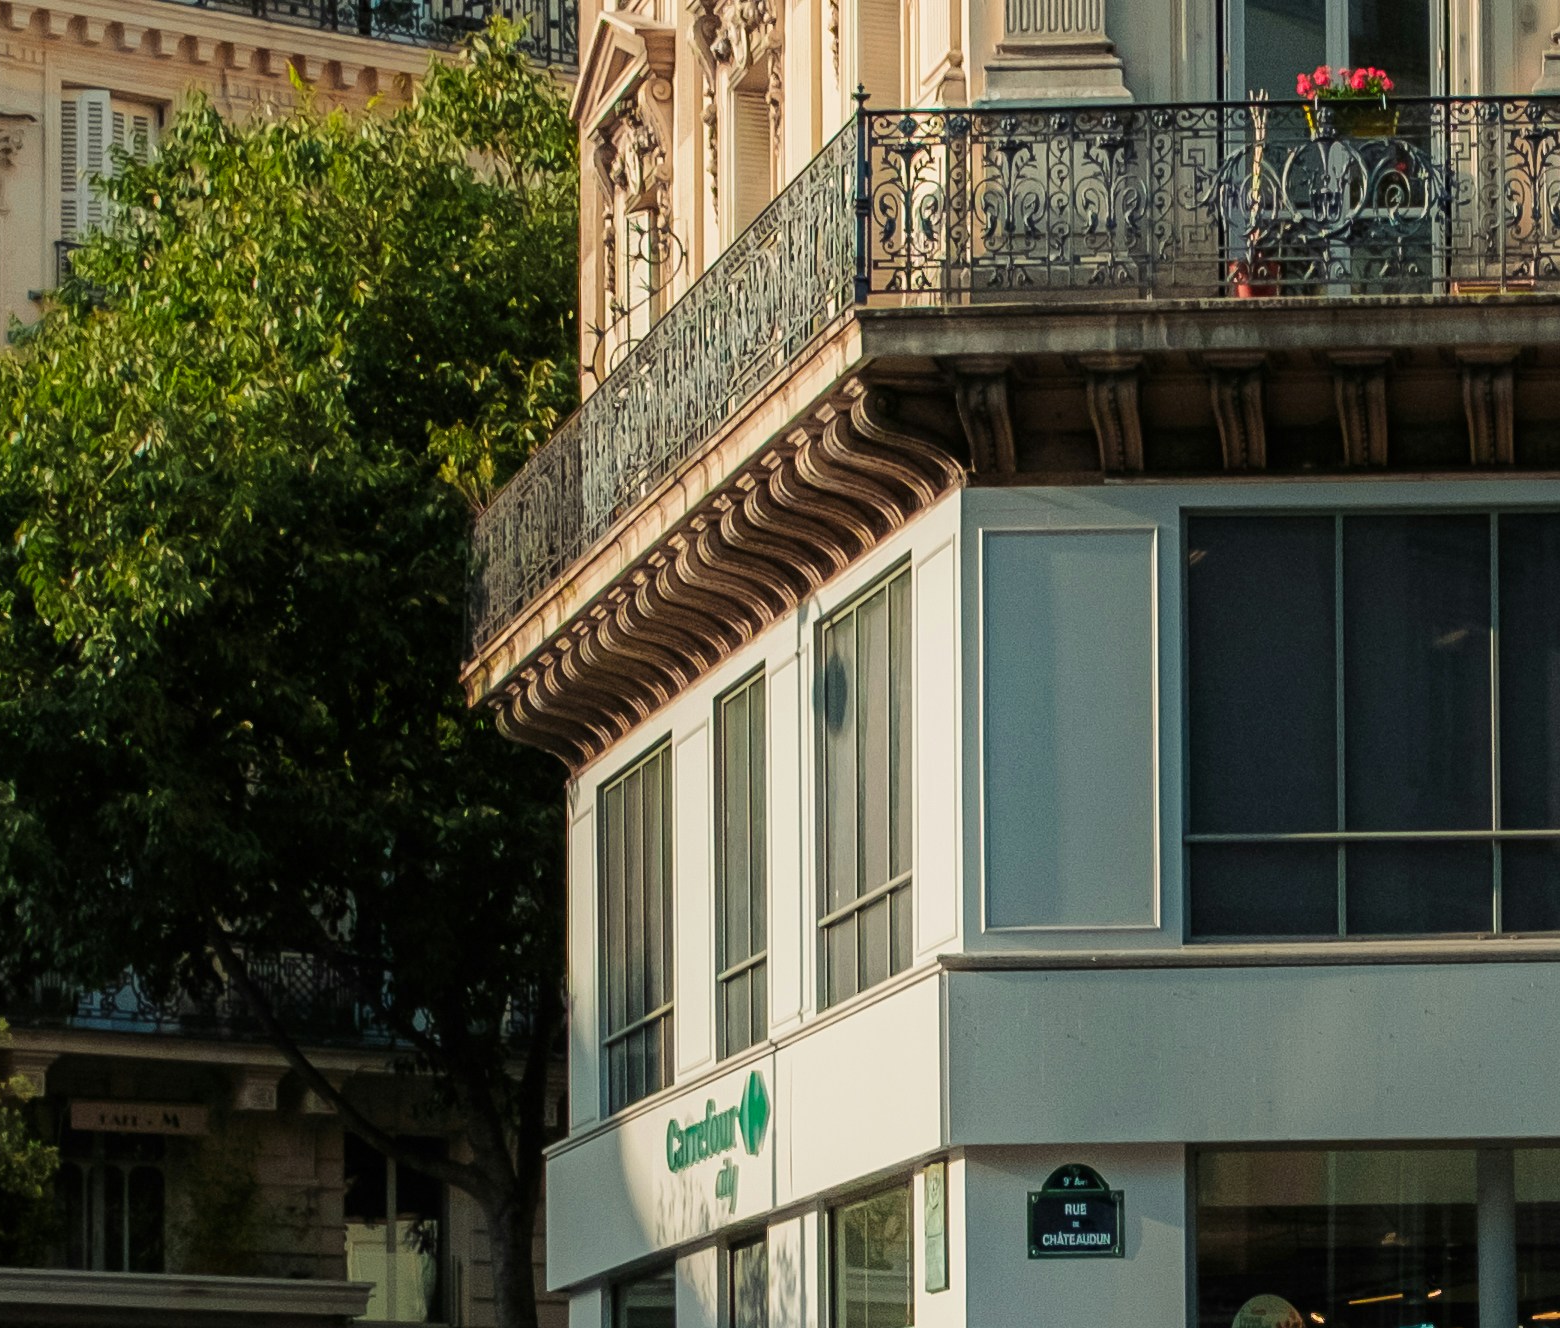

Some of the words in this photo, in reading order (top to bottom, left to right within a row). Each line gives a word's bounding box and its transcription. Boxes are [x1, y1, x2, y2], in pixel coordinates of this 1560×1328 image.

[666, 1099, 739, 1174] Carrefour
[715, 1157, 739, 1214] city
[1064, 1203, 1087, 1216] RUE
[1042, 1231, 1111, 1246] CHÂTEAUDUN
